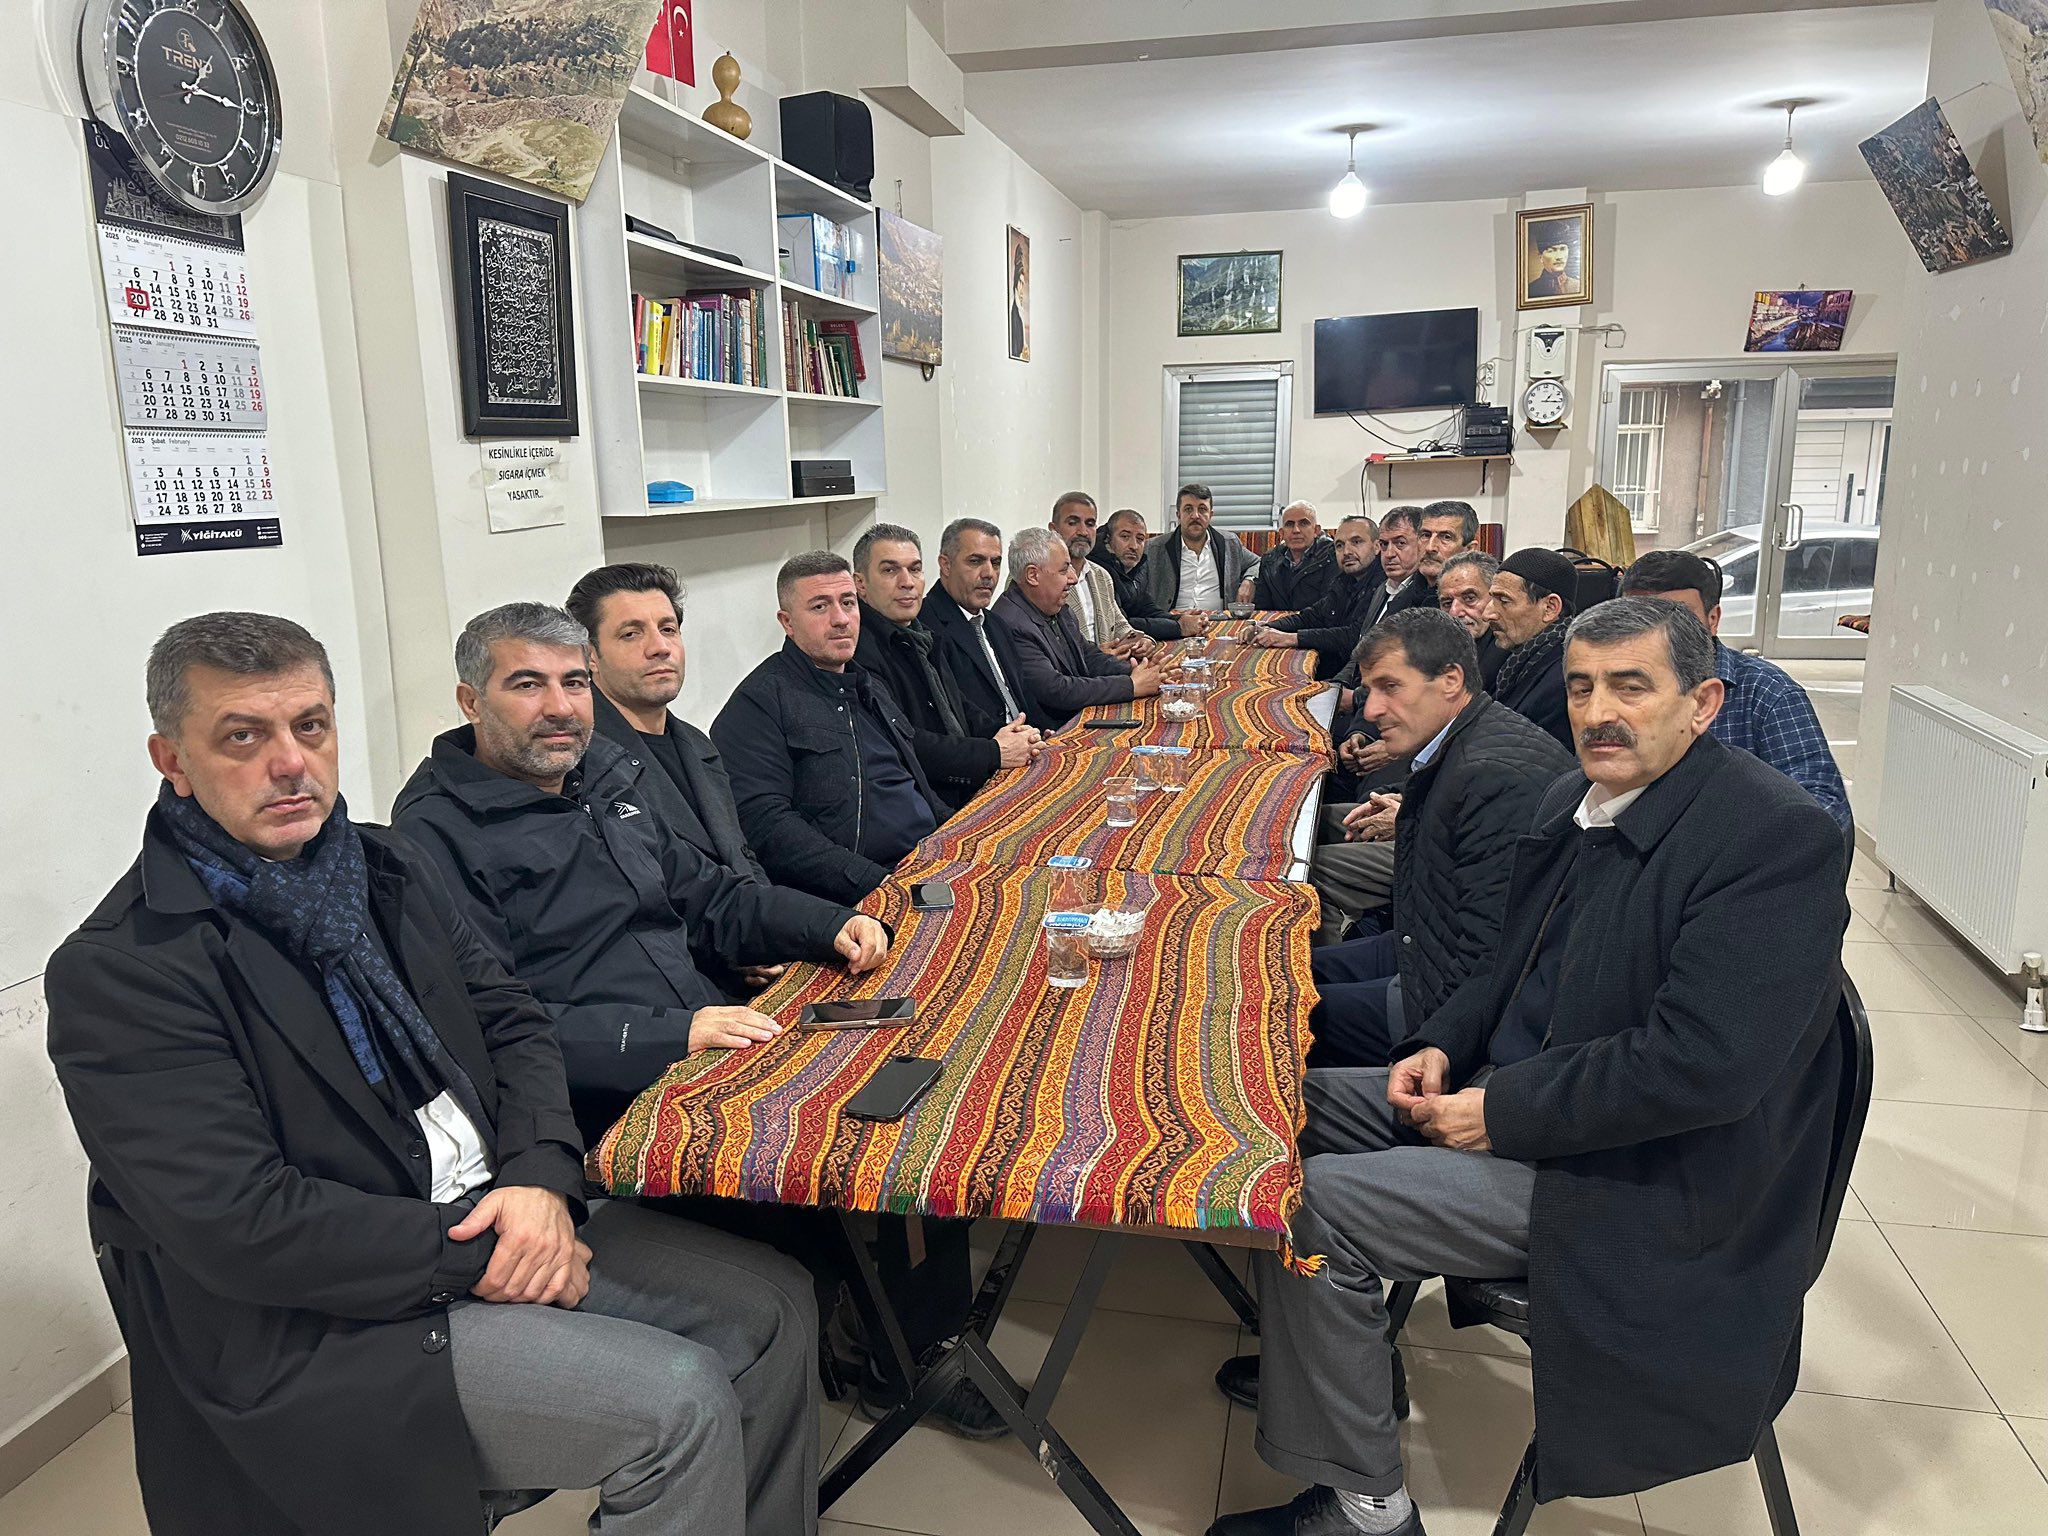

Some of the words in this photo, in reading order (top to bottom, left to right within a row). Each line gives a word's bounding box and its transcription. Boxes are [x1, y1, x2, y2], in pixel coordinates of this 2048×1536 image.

[161, 45, 212, 74] TREND
[105, 232, 120, 240] 2025
[126, 236, 140, 244] Ocak
[169, 262, 174, 271] 1
[186, 264, 192, 274] 2
[205, 268, 210, 278] 3
[223, 271, 228, 280] 4
[240, 274, 246, 284] 5
[134, 267, 140, 278] 6
[153, 270, 158, 280] 7
[172, 274, 177, 284] 8
[188, 277, 194, 288] 9
[202, 280, 213, 290] 10
[220, 283, 230, 293] 11
[236, 286, 247, 296] 12
[129, 280, 141, 290] 13
[150, 283, 161, 294] 14
[168, 286, 180, 297] 15
[186, 290, 196, 300] 16
[204, 292, 214, 302] 17
[221, 295, 232, 306] 18
[238, 298, 248, 308] 19
[130, 294, 144, 304] 20
[151, 296, 164, 307] 21
[170, 299, 182, 310] 22
[188, 302, 198, 312] 23
[205, 305, 216, 316] 24
[222, 308, 234, 318] 25
[240, 310, 250, 320] 26
[154, 310, 166, 320] 28
[172, 312, 184, 323] 29
[190, 314, 201, 326] 30
[206, 317, 218, 328] 31
[118, 335, 132, 343] 2025
[182, 360, 187, 370] 1
[199, 360, 206, 371] 2
[218, 362, 224, 372] 3
[235, 364, 240, 374] 4
[251, 366, 256, 375] 5
[146, 369, 152, 380] 6
[164, 370, 170, 380] 7
[184, 372, 190, 382] 8
[202, 374, 208, 384] 9
[214, 374, 226, 385] 10
[232, 376, 242, 386] 11
[248, 378, 258, 387] 12
[142, 382, 154, 392] 13
[162, 383, 173, 394] 14
[180, 384, 192, 395] 15
[198, 386, 210, 396] 16
[216, 387, 226, 396] 17
[234, 388, 244, 398] 18
[250, 390, 260, 399] 19
[144, 395, 156, 406] 20
[163, 396, 175, 406] 21
[182, 397, 194, 408] 22
[200, 398, 212, 408] 23
[218, 399, 230, 409] 24
[235, 400, 246, 410] 25
[252, 401, 262, 411] 26
[146, 408, 158, 418] 27
[166, 409, 178, 420] 28
[184, 410, 196, 420] 29
[202, 410, 214, 420] 30
[220, 412, 232, 422] 31
[169, 438, 190, 446] February
[246, 455, 251, 464] 1
[262, 455, 268, 464] 2
[489, 446, 527, 459] KESİNLİKLE
[528, 446, 554, 460] İÇERİDE
[157, 467, 164, 478] 3
[177, 467, 183, 478] 4
[196, 467, 202, 477] 5
[213, 467, 220, 477] 6
[230, 467, 236, 476] 7
[248, 467, 254, 476] 8
[264, 467, 270, 476] 9
[525, 467, 546, 480] İÇMEK
[154, 480, 166, 490] 10
[174, 480, 185, 490] 11
[192, 480, 204, 490] 12
[210, 480, 220, 490] 13
[228, 479, 239, 488] 14
[245, 478, 254, 488] 15
[261, 478, 272, 488] 16
[156, 492, 168, 502] 17
[176, 492, 188, 502] 18
[194, 492, 206, 502] 19
[212, 492, 224, 502] 20
[229, 491, 240, 500] 21
[246, 490, 257, 500] 22
[262, 490, 272, 500] 23
[158, 506, 172, 516] 24
[178, 504, 190, 515] 25
[196, 504, 208, 514] 26
[214, 504, 224, 514] 27
[231, 502, 242, 512] 28
